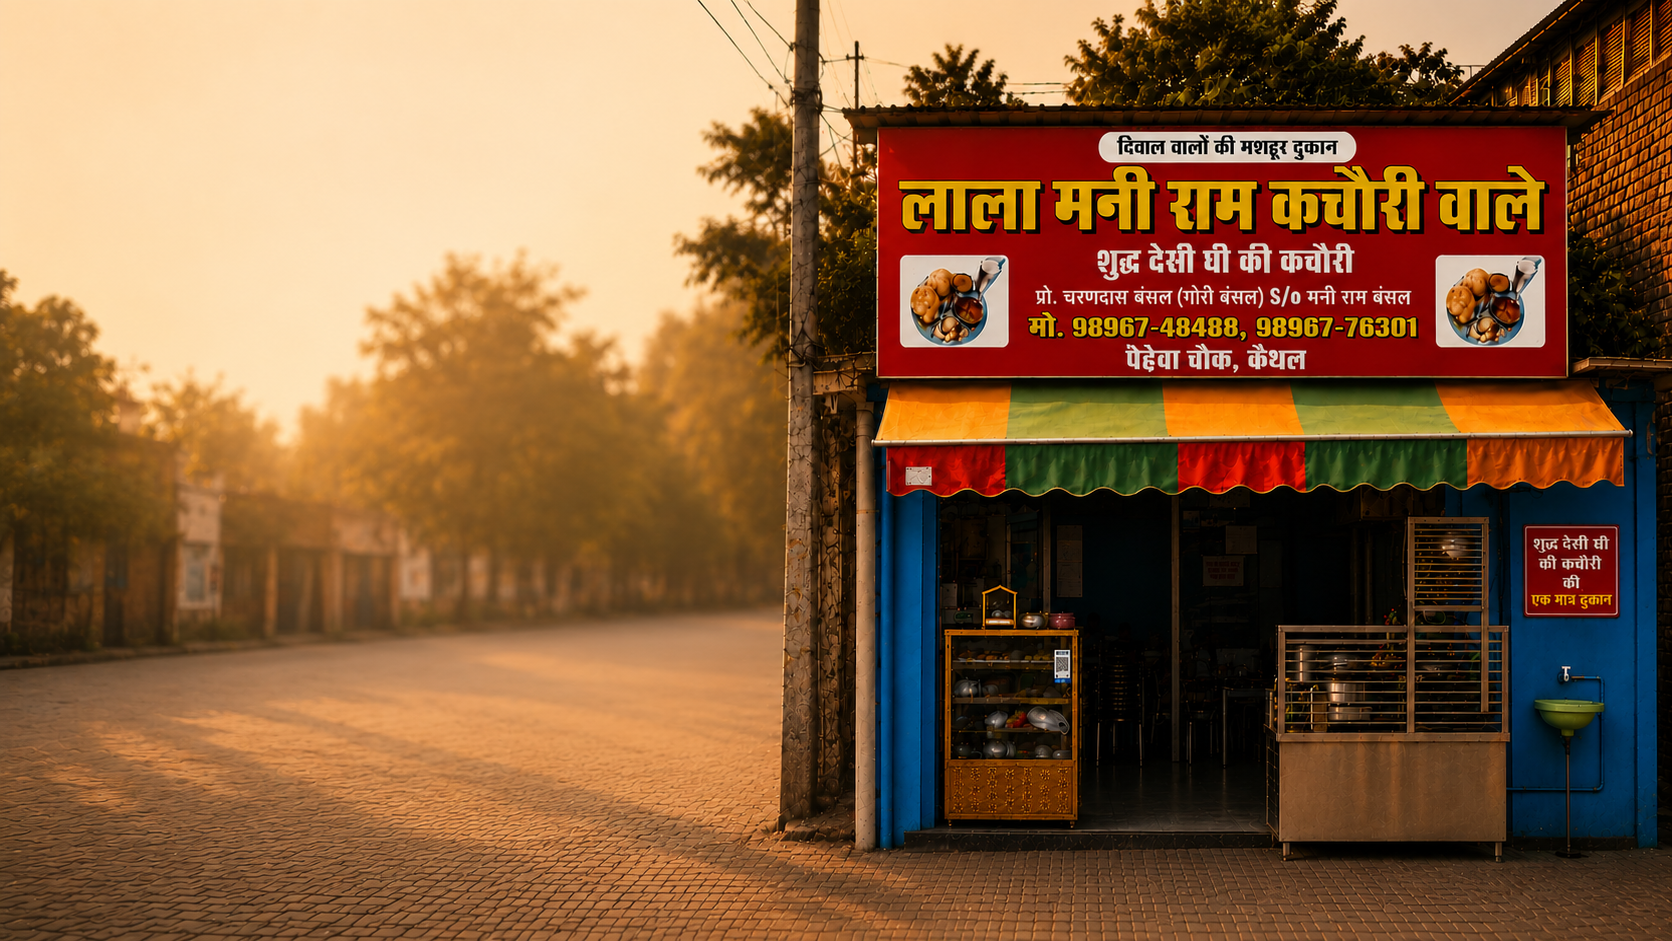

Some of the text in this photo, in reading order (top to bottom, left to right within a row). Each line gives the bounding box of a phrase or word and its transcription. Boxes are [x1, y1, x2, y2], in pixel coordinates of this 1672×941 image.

[1117, 134, 1166, 155] दिवाल
[1170, 134, 1209, 155] वालों
[1213, 134, 1236, 155] की
[1292, 140, 1339, 160] दुकान
[899, 165, 1549, 234] लाला मनी राम कचौरी वाले
[1097, 243, 1355, 281] शुद्ध देसी घी की कचौरी
[1035, 285, 1057, 305] प्रो.
[1063, 290, 1129, 305] चरणदास
[1134, 286, 1173, 305] बंसल
[1177, 285, 1214, 308] (गोरी
[1219, 286, 1264, 308] बंसल)
[1306, 285, 1336, 305] मनी
[1341, 290, 1368, 305] राम
[1372, 286, 1412, 305] बंसल
[1028, 311, 1419, 341] मो. 98967-48488, 98967-76301
[1186, 343, 1239, 373] चौक,
[1246, 343, 1307, 370] कैथल
[1562, 535, 1589, 550] देसी
[1538, 555, 1602, 570] की कचौरी
[1562, 574, 1580, 589] की
[1531, 594, 1612, 609] एक मात्र दुकान
